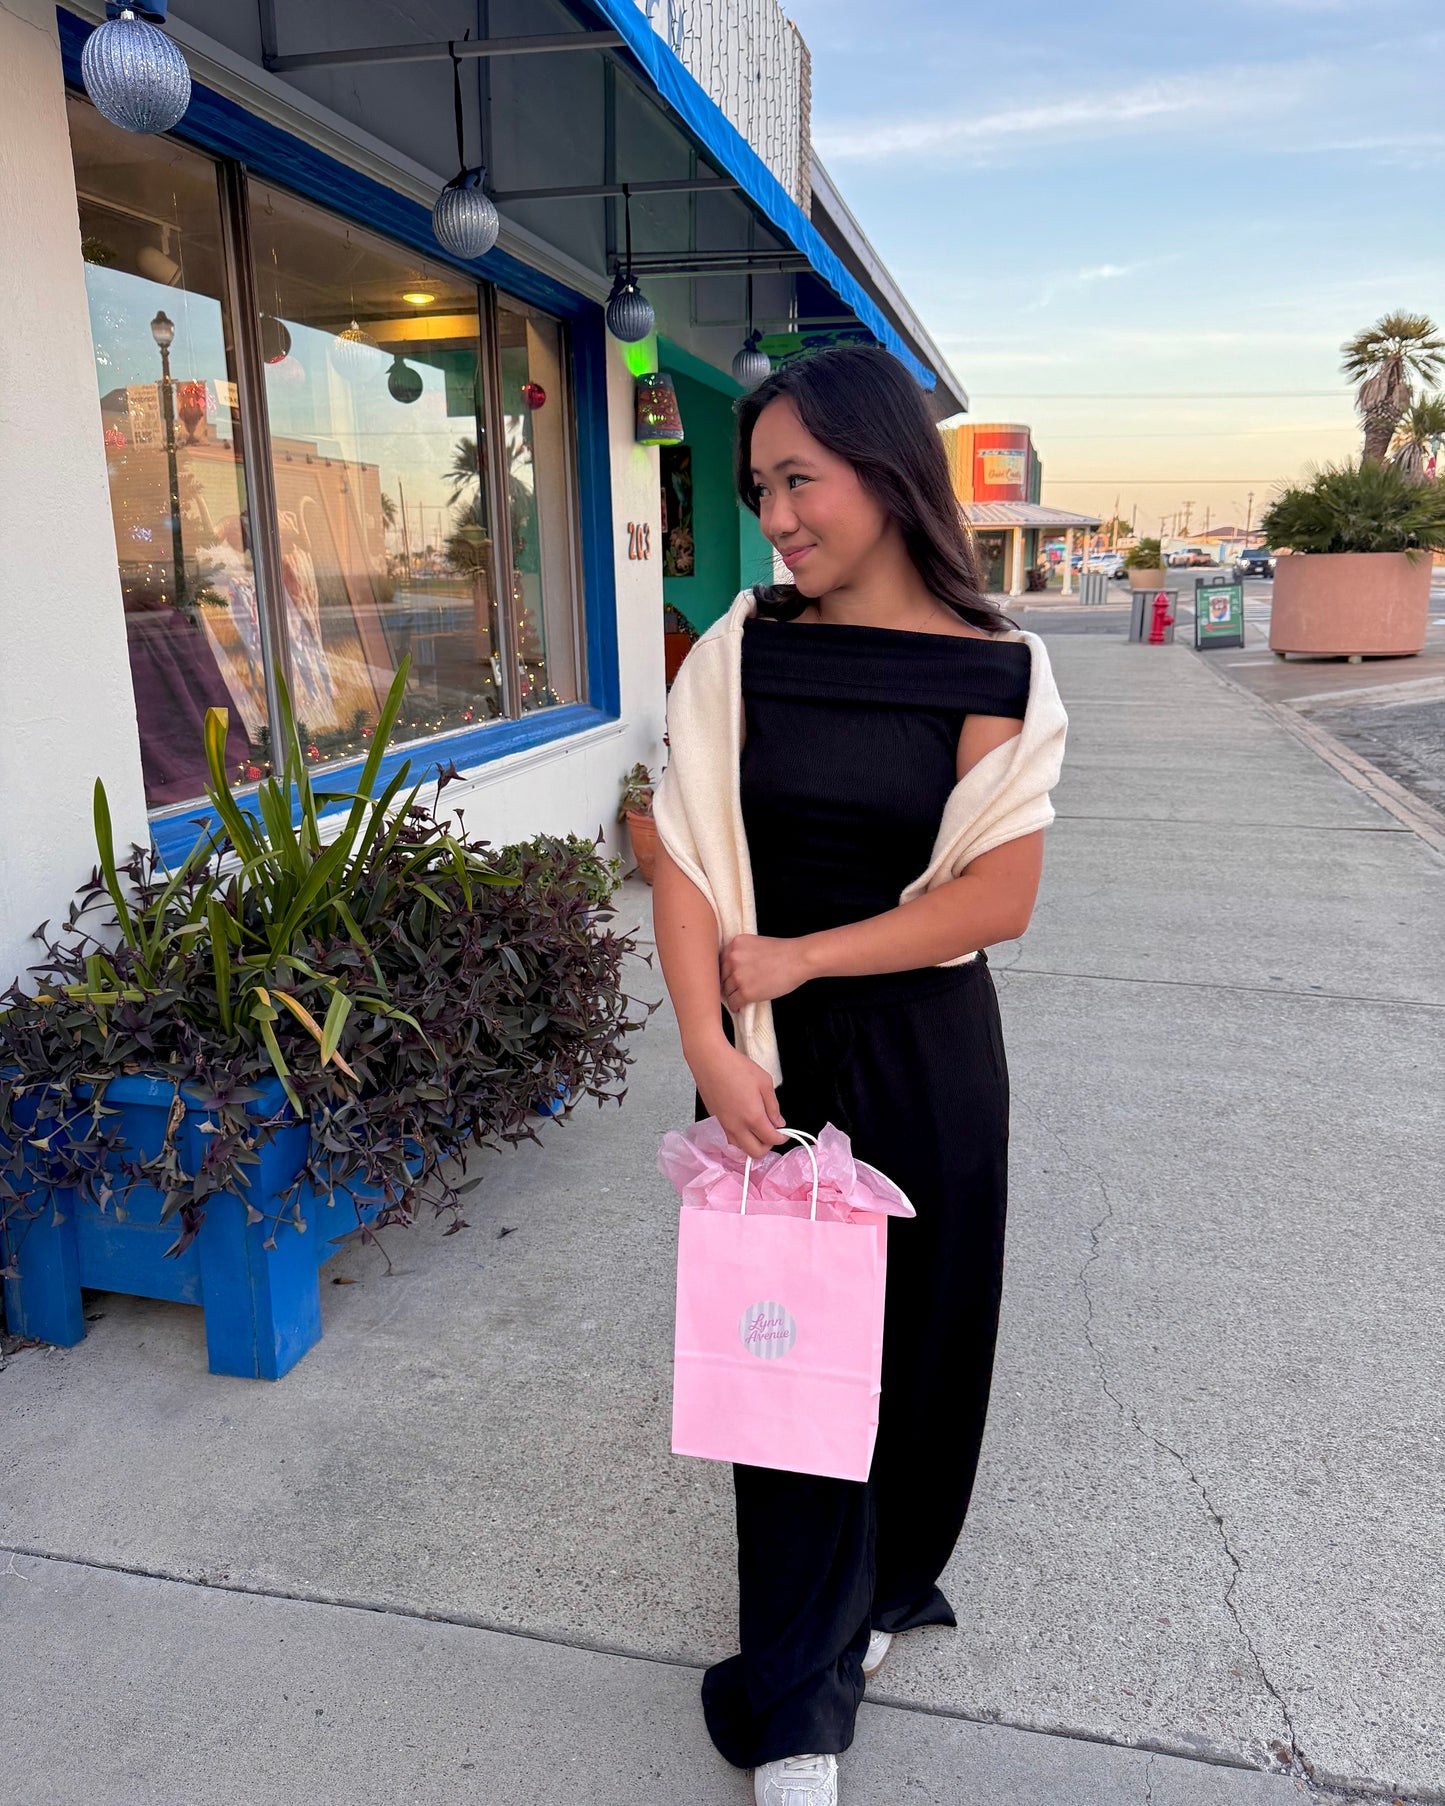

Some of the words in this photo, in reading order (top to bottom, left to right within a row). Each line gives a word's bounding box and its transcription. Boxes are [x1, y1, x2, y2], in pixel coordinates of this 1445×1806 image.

[627, 521, 650, 561] 203
[748, 1313, 783, 1333] Lynn
[745, 1329, 790, 1344] Avenue
